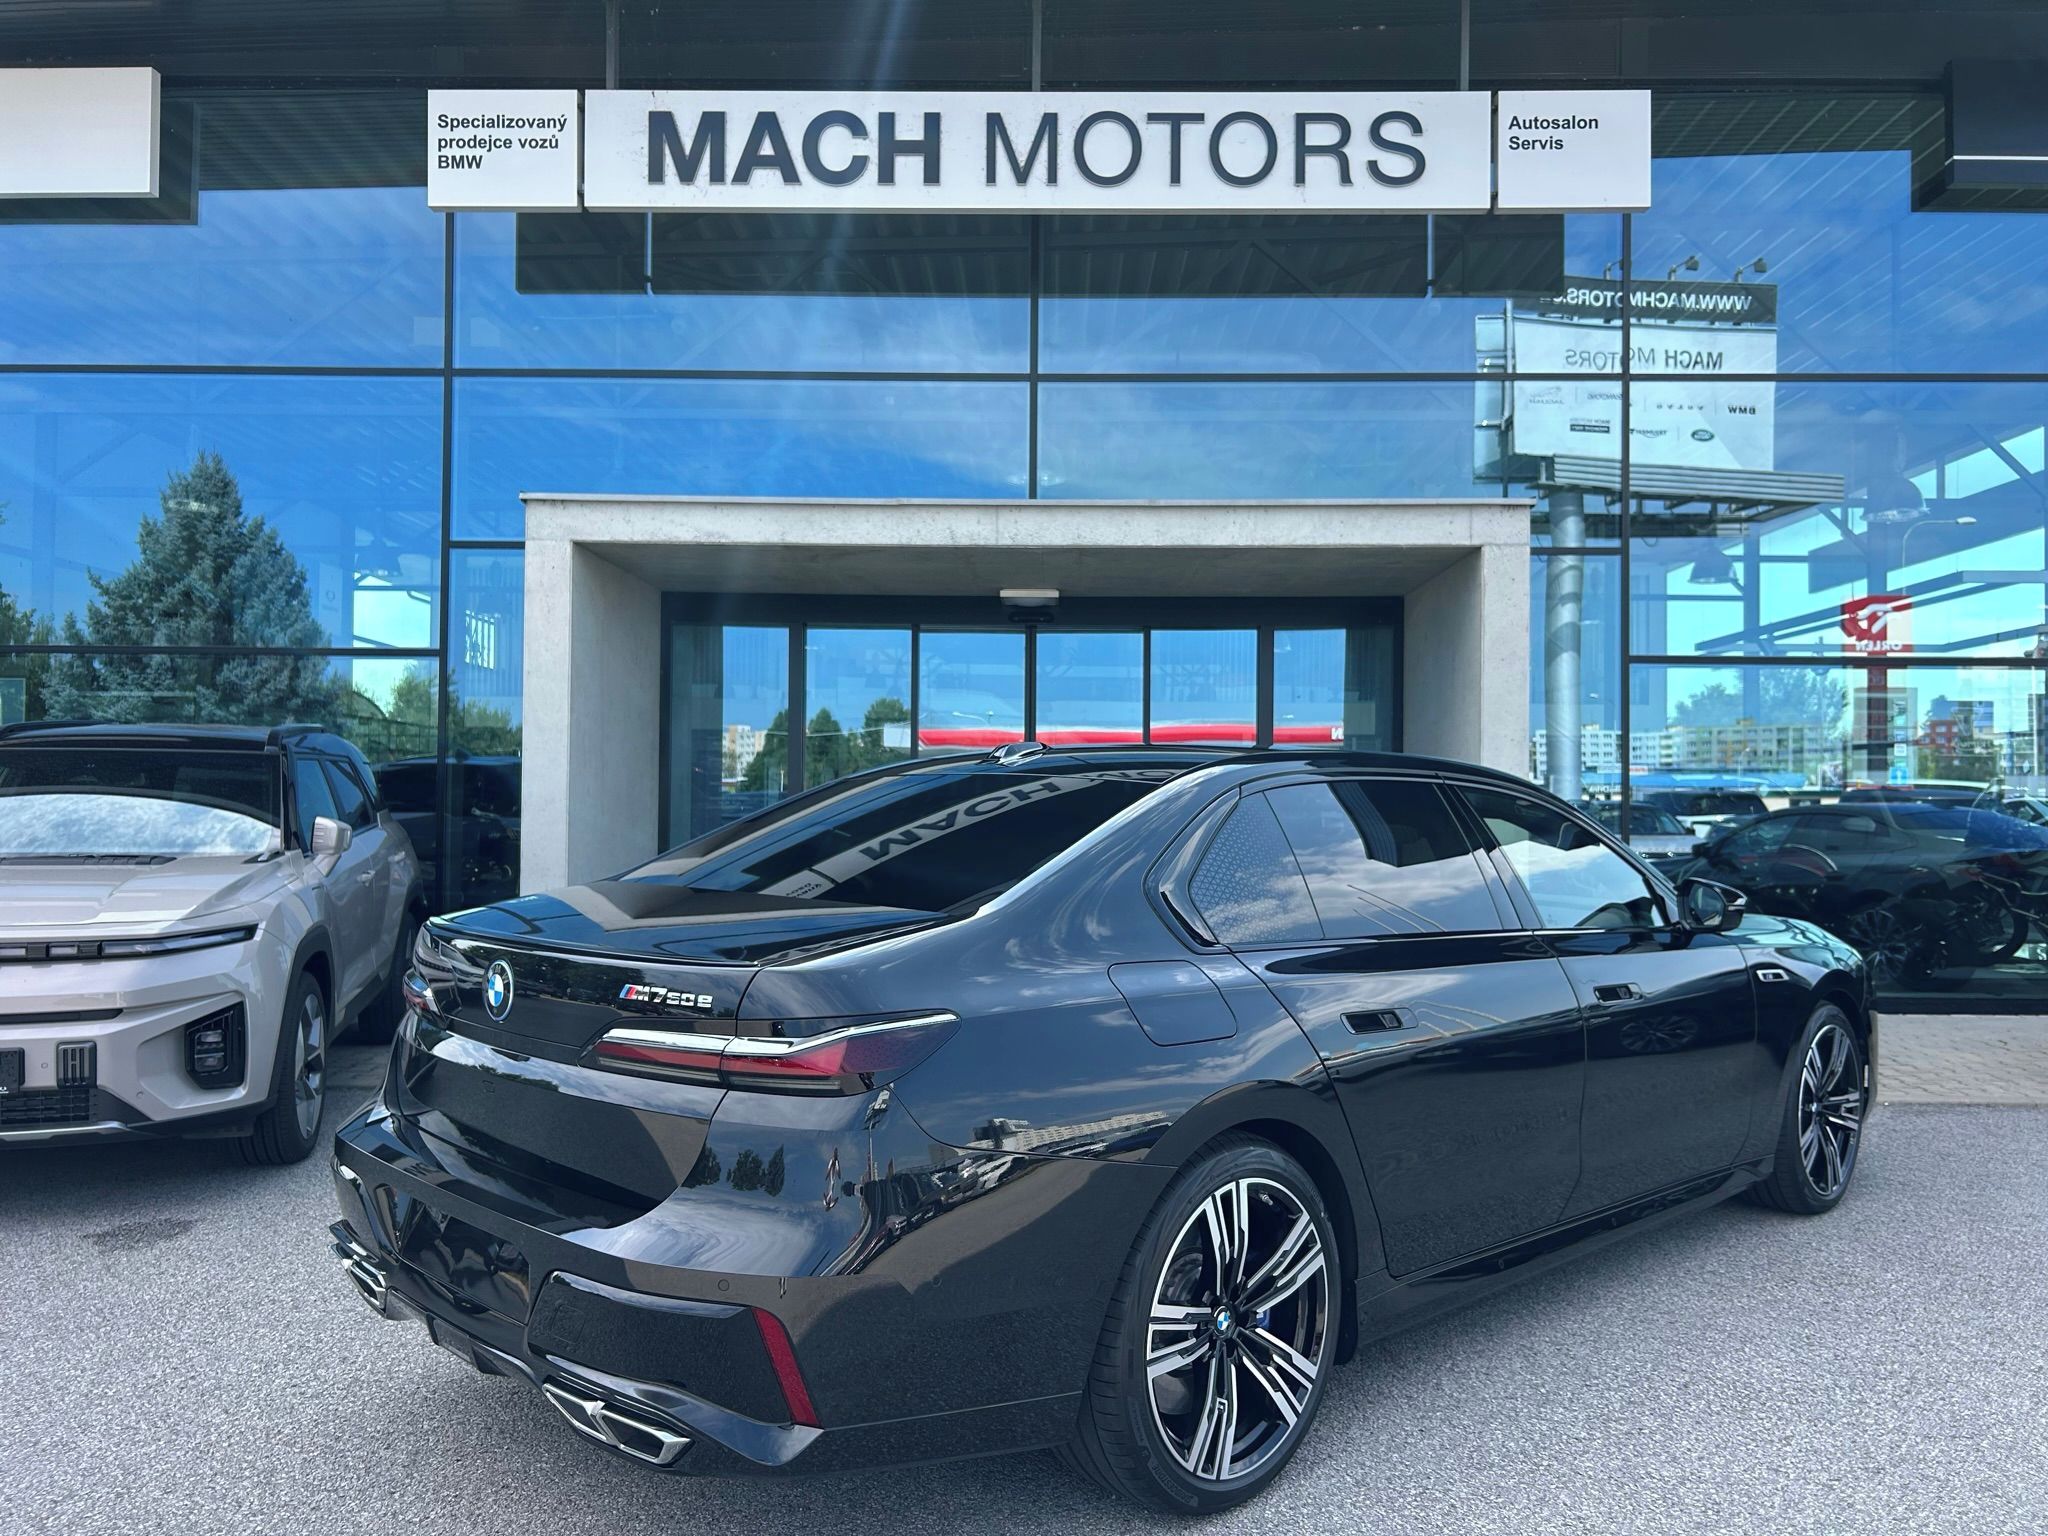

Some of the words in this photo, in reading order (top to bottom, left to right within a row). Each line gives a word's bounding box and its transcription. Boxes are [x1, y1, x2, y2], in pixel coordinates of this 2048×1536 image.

[438, 114, 567, 132] Specializovaný
[1509, 115, 1598, 129] Autosalon
[438, 135, 512, 152] prodejce
[518, 135, 558, 148] vozů
[648, 110, 941, 186] MACH
[986, 111, 1425, 187] MOTORS
[1509, 136, 1563, 150] Servis
[439, 155, 482, 168] BMW
[620, 983, 714, 1009] M750e
